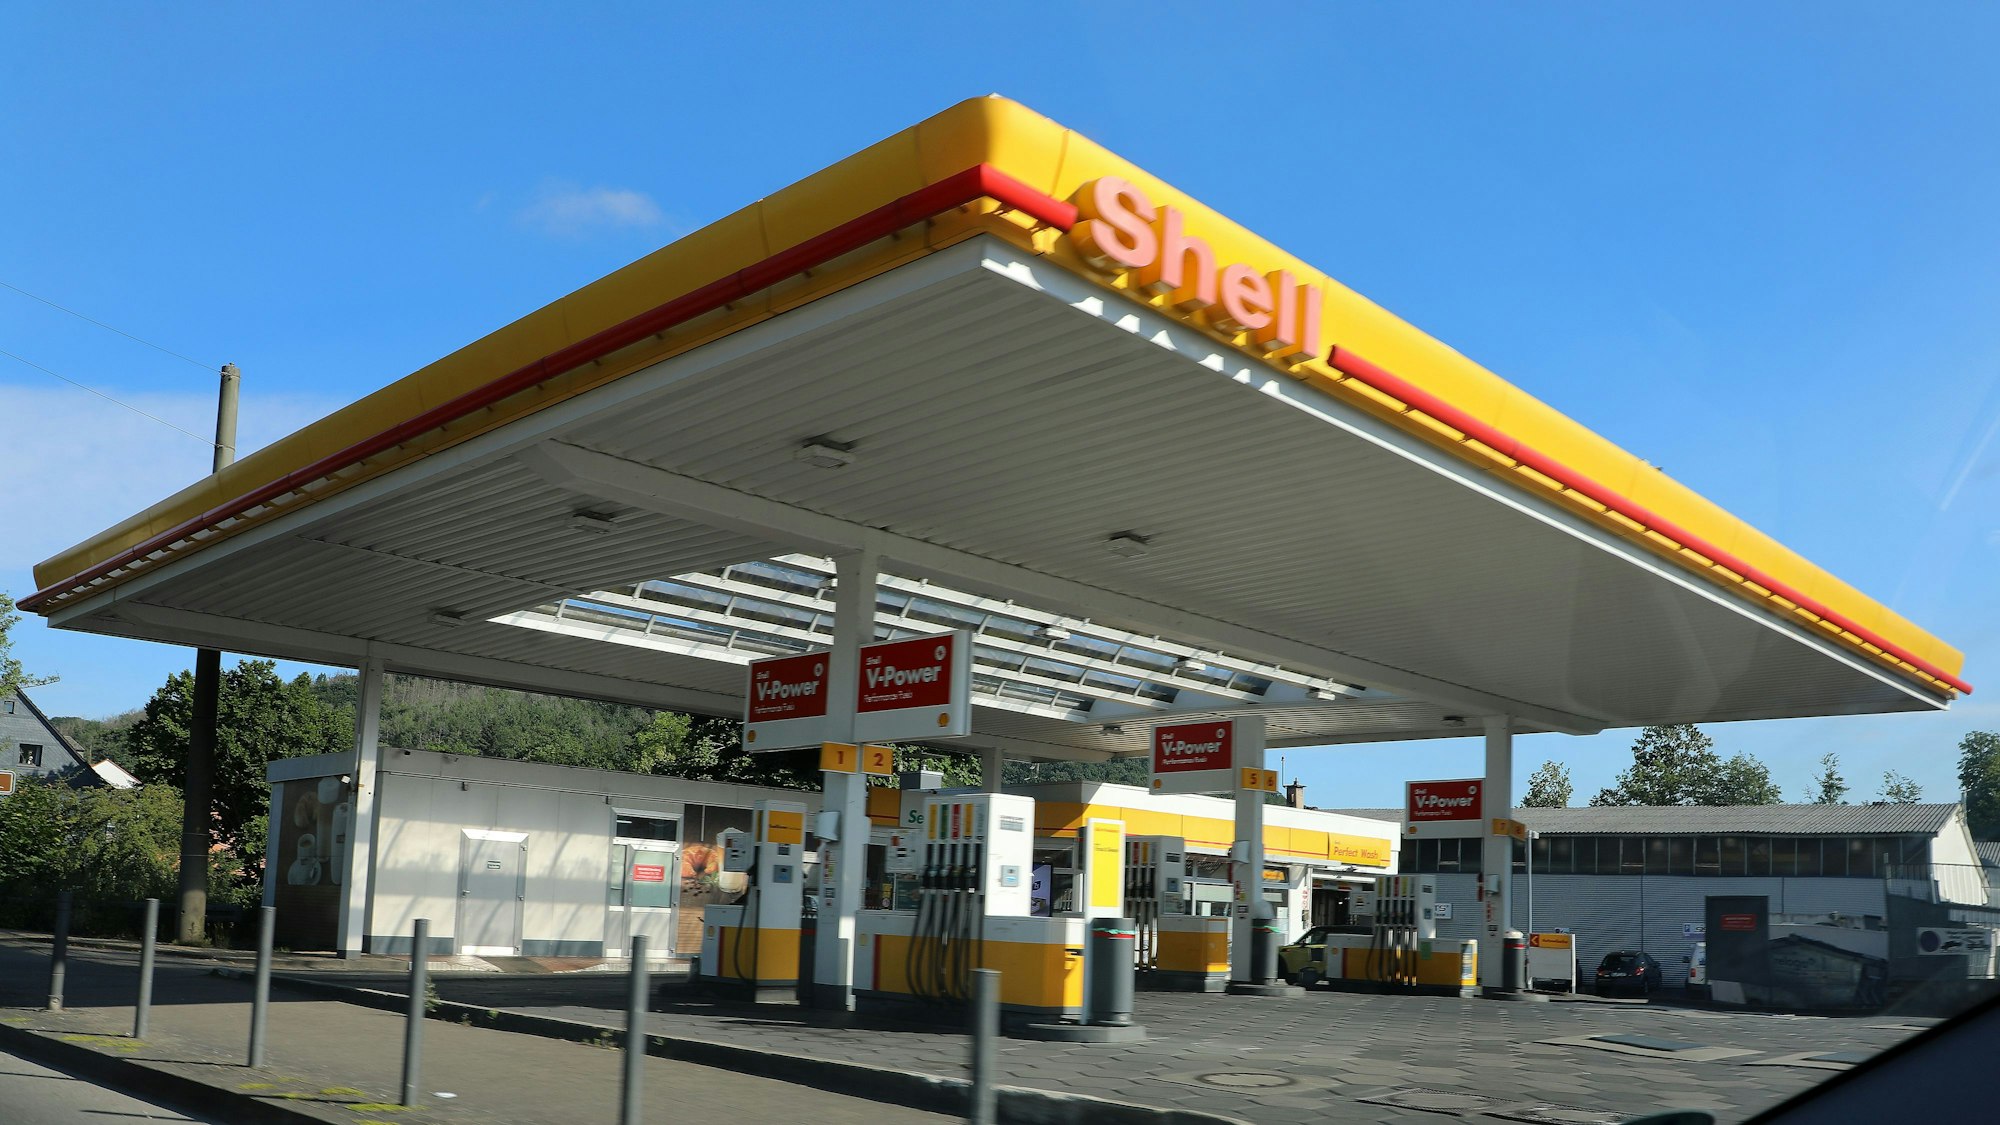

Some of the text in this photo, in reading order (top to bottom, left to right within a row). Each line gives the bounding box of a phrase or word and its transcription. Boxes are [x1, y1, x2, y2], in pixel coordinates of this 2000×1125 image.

[1088, 175, 1323, 359] Shell
[865, 665, 942, 689] V-Power
[756, 680, 820, 701] V-Power
[1161, 740, 1223, 756] V-Power
[836, 750, 844, 765] 1
[873, 752, 884, 767] 2
[1414, 795, 1475, 809] V-Power
[1333, 846, 1379, 860] Perfect Wash
